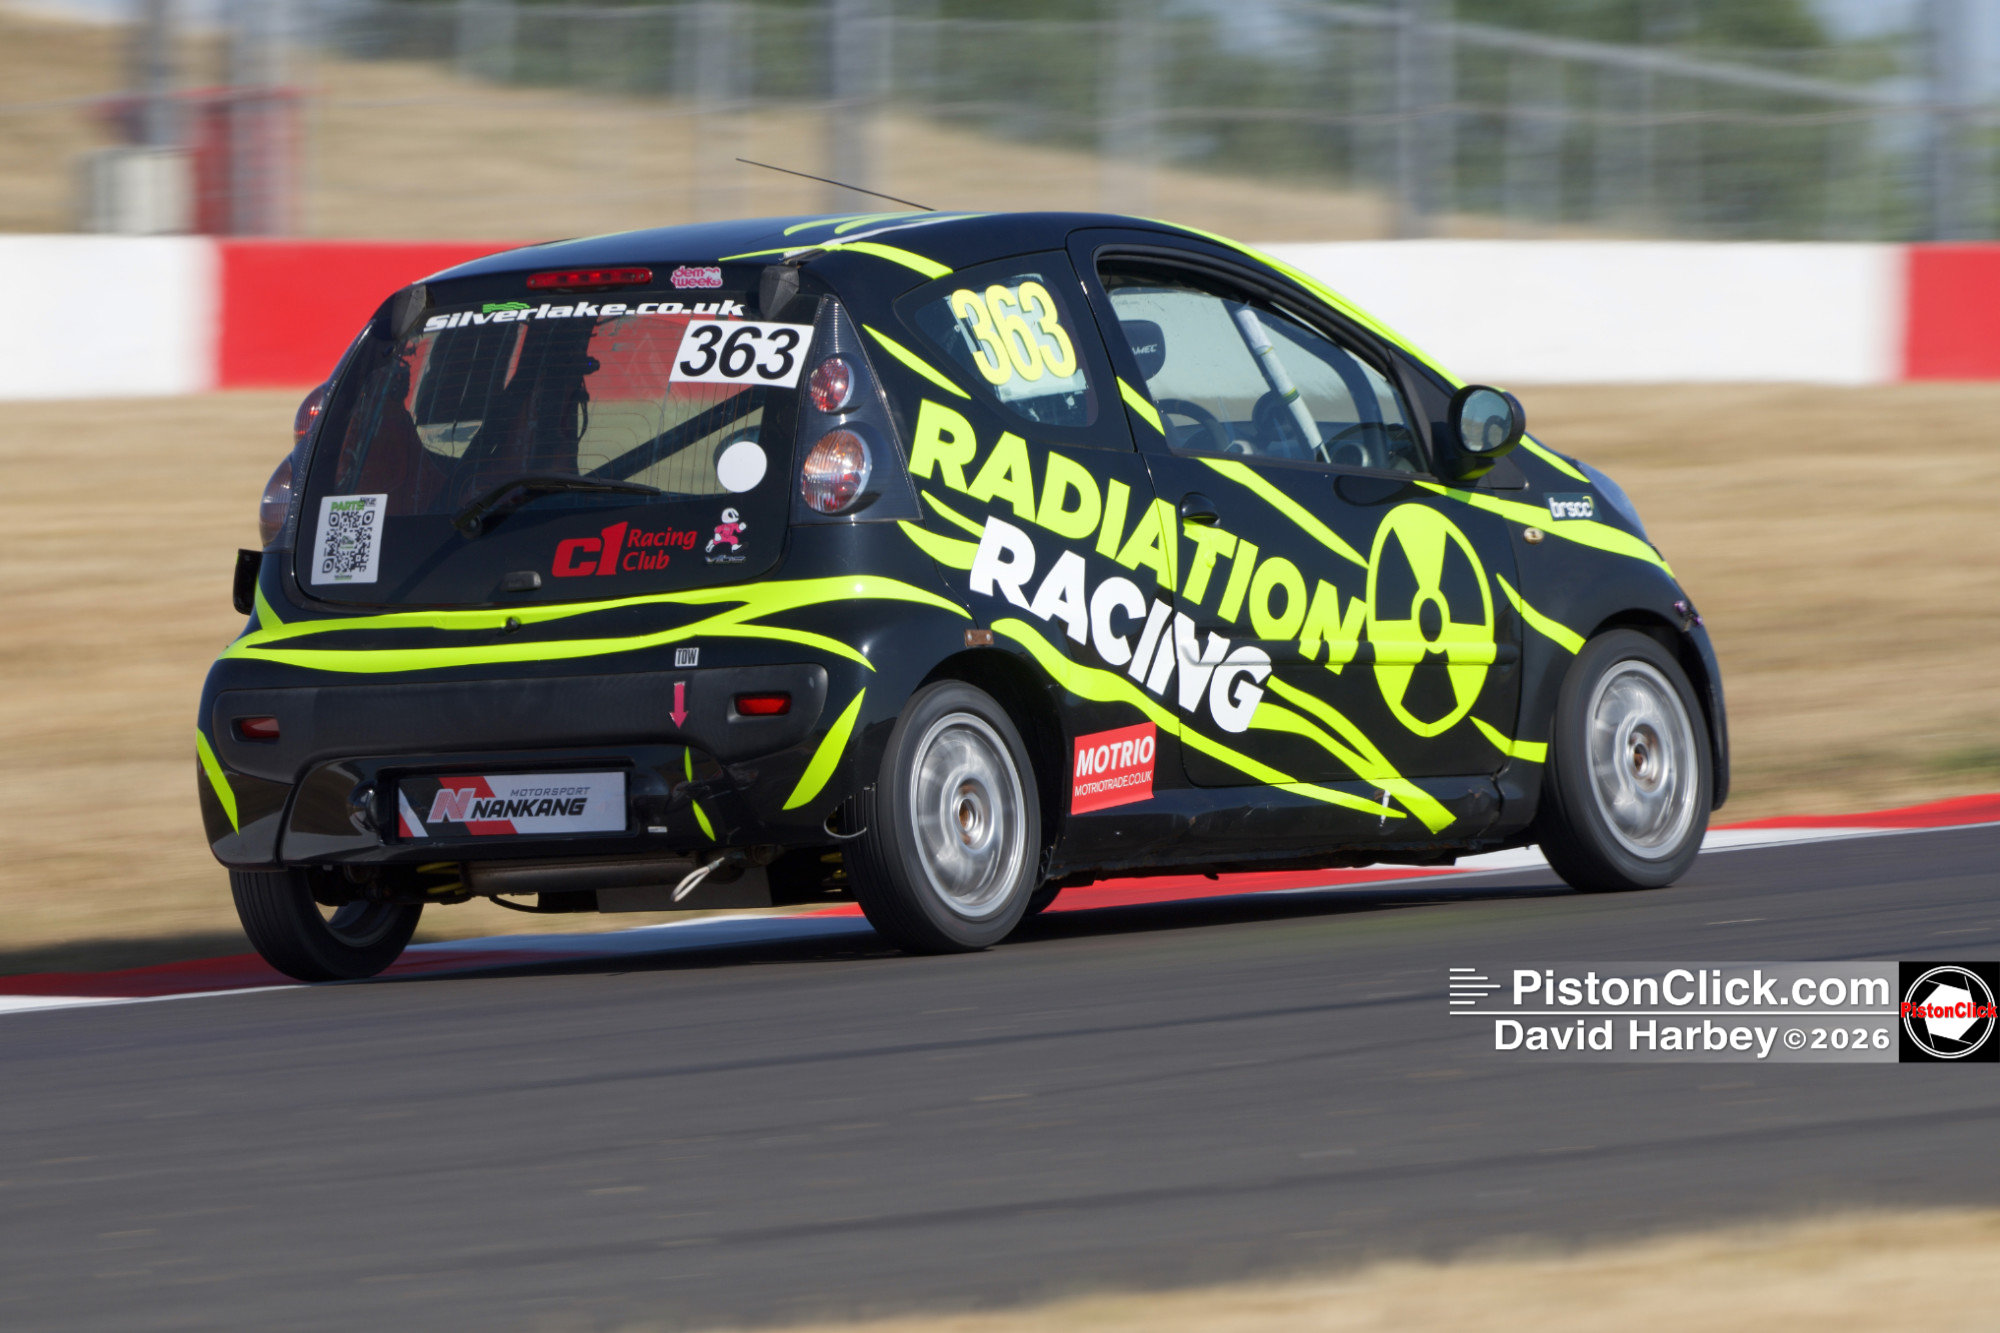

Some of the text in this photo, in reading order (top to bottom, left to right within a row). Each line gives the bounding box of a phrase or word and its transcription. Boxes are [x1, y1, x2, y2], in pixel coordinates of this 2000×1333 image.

[952, 281, 1077, 385] 363
[679, 324, 800, 380] 363
[628, 527, 697, 550] Racing
[908, 399, 1367, 675] RADIATION
[623, 551, 670, 571] Club
[970, 516, 1271, 732] RACING
[677, 650, 697, 664] TOW
[1076, 736, 1155, 777] MOTRIO
[510, 787, 591, 797] MOTORSPORT
[471, 798, 587, 819] NANKANG
